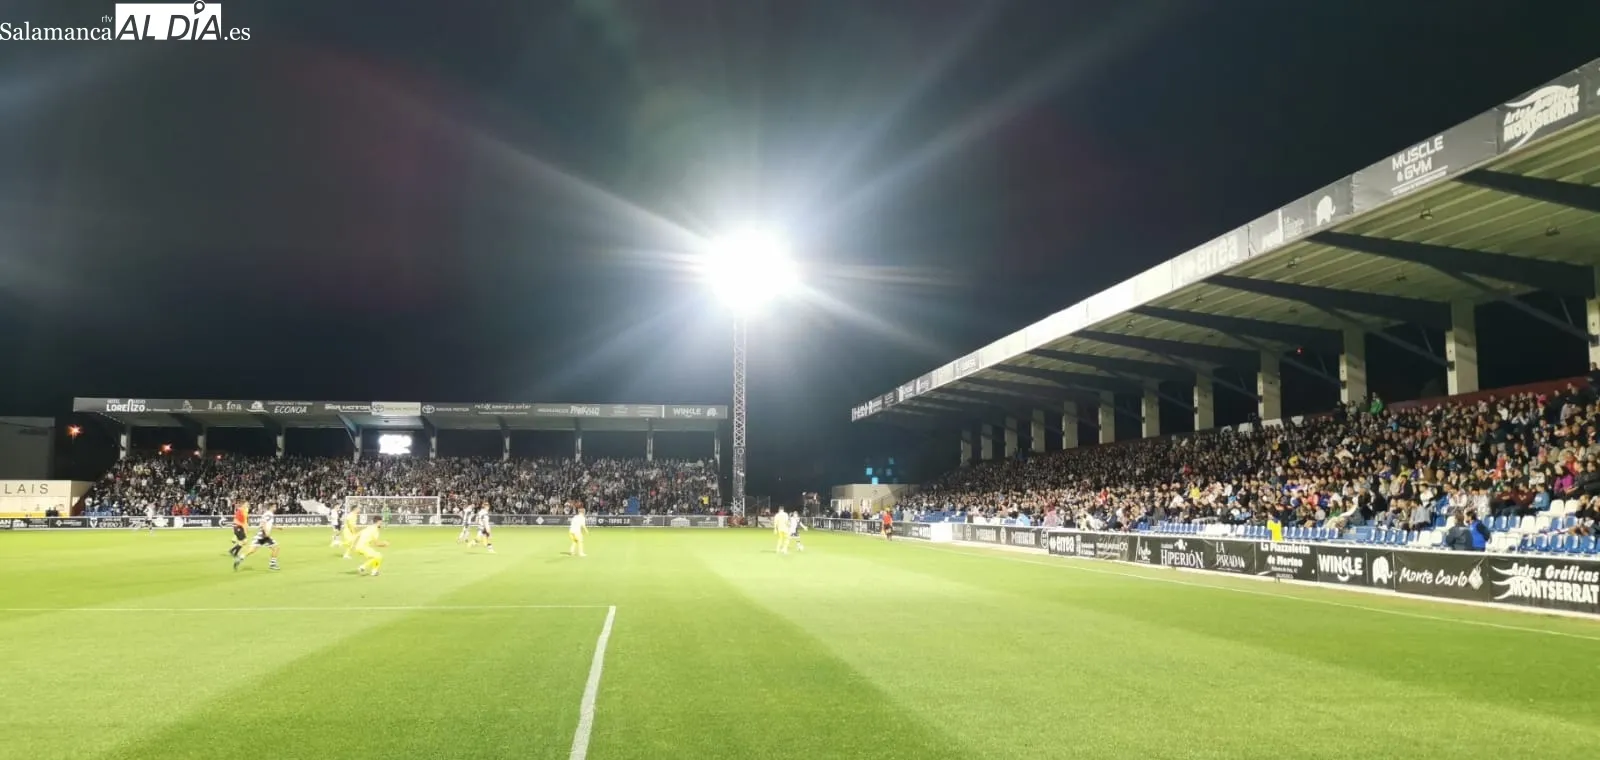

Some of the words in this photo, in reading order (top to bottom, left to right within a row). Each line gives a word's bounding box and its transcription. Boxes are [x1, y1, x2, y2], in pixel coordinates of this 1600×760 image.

[1392, 135, 1444, 171] MUSCLE
[1404, 157, 1432, 180] GYM
[1216, 541, 1225, 554] LA
[1161, 548, 1204, 569] HIPERIÓN
[1399, 567, 1433, 585] Monte
[1435, 569, 1468, 588] Carlo
[1511, 562, 1541, 579] Artes
[1545, 564, 1600, 583] Gráficas
[1511, 577, 1600, 605] MONTSERRAT
